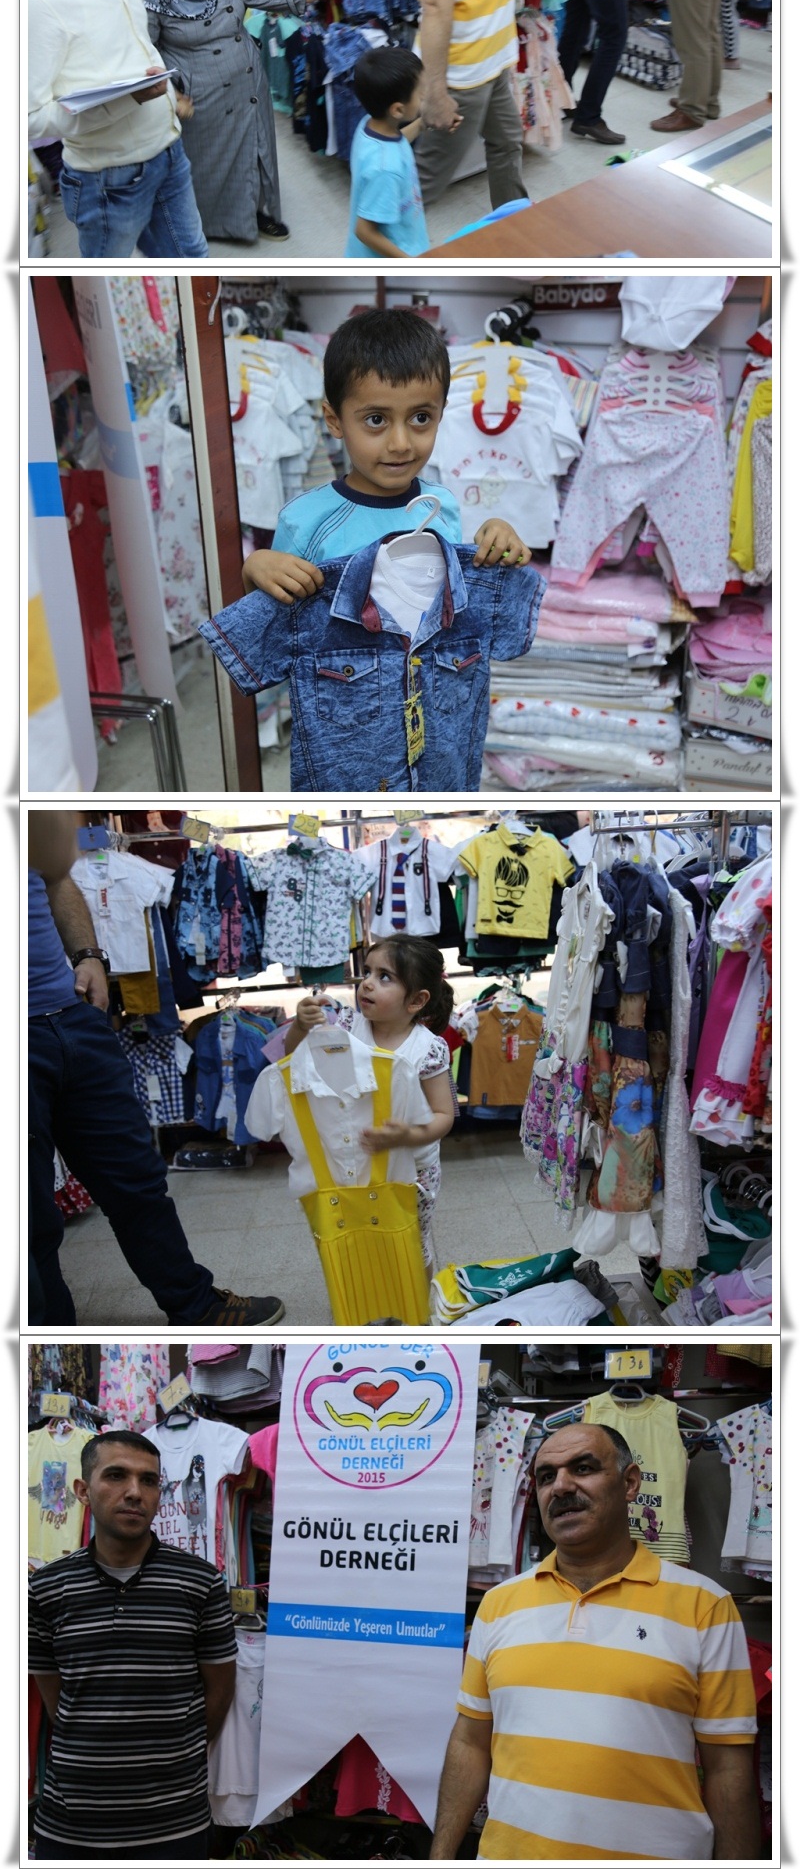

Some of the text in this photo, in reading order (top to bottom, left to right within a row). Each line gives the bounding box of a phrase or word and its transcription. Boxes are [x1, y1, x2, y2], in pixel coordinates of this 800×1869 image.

[534, 284, 607, 308] Babydo
[318, 1434, 431, 1453] GÖNÜL ELÇİLERİ
[341, 1454, 404, 1470] DERNEĞİ
[357, 1472, 386, 1483] 2015
[156, 1501, 200, 1519] OUNG
[283, 1517, 459, 1546] GÖNÜL ELÇİLERİ
[320, 1548, 416, 1571] DERNEĞİ
[354, 1618, 393, 1637] Yeşeren
